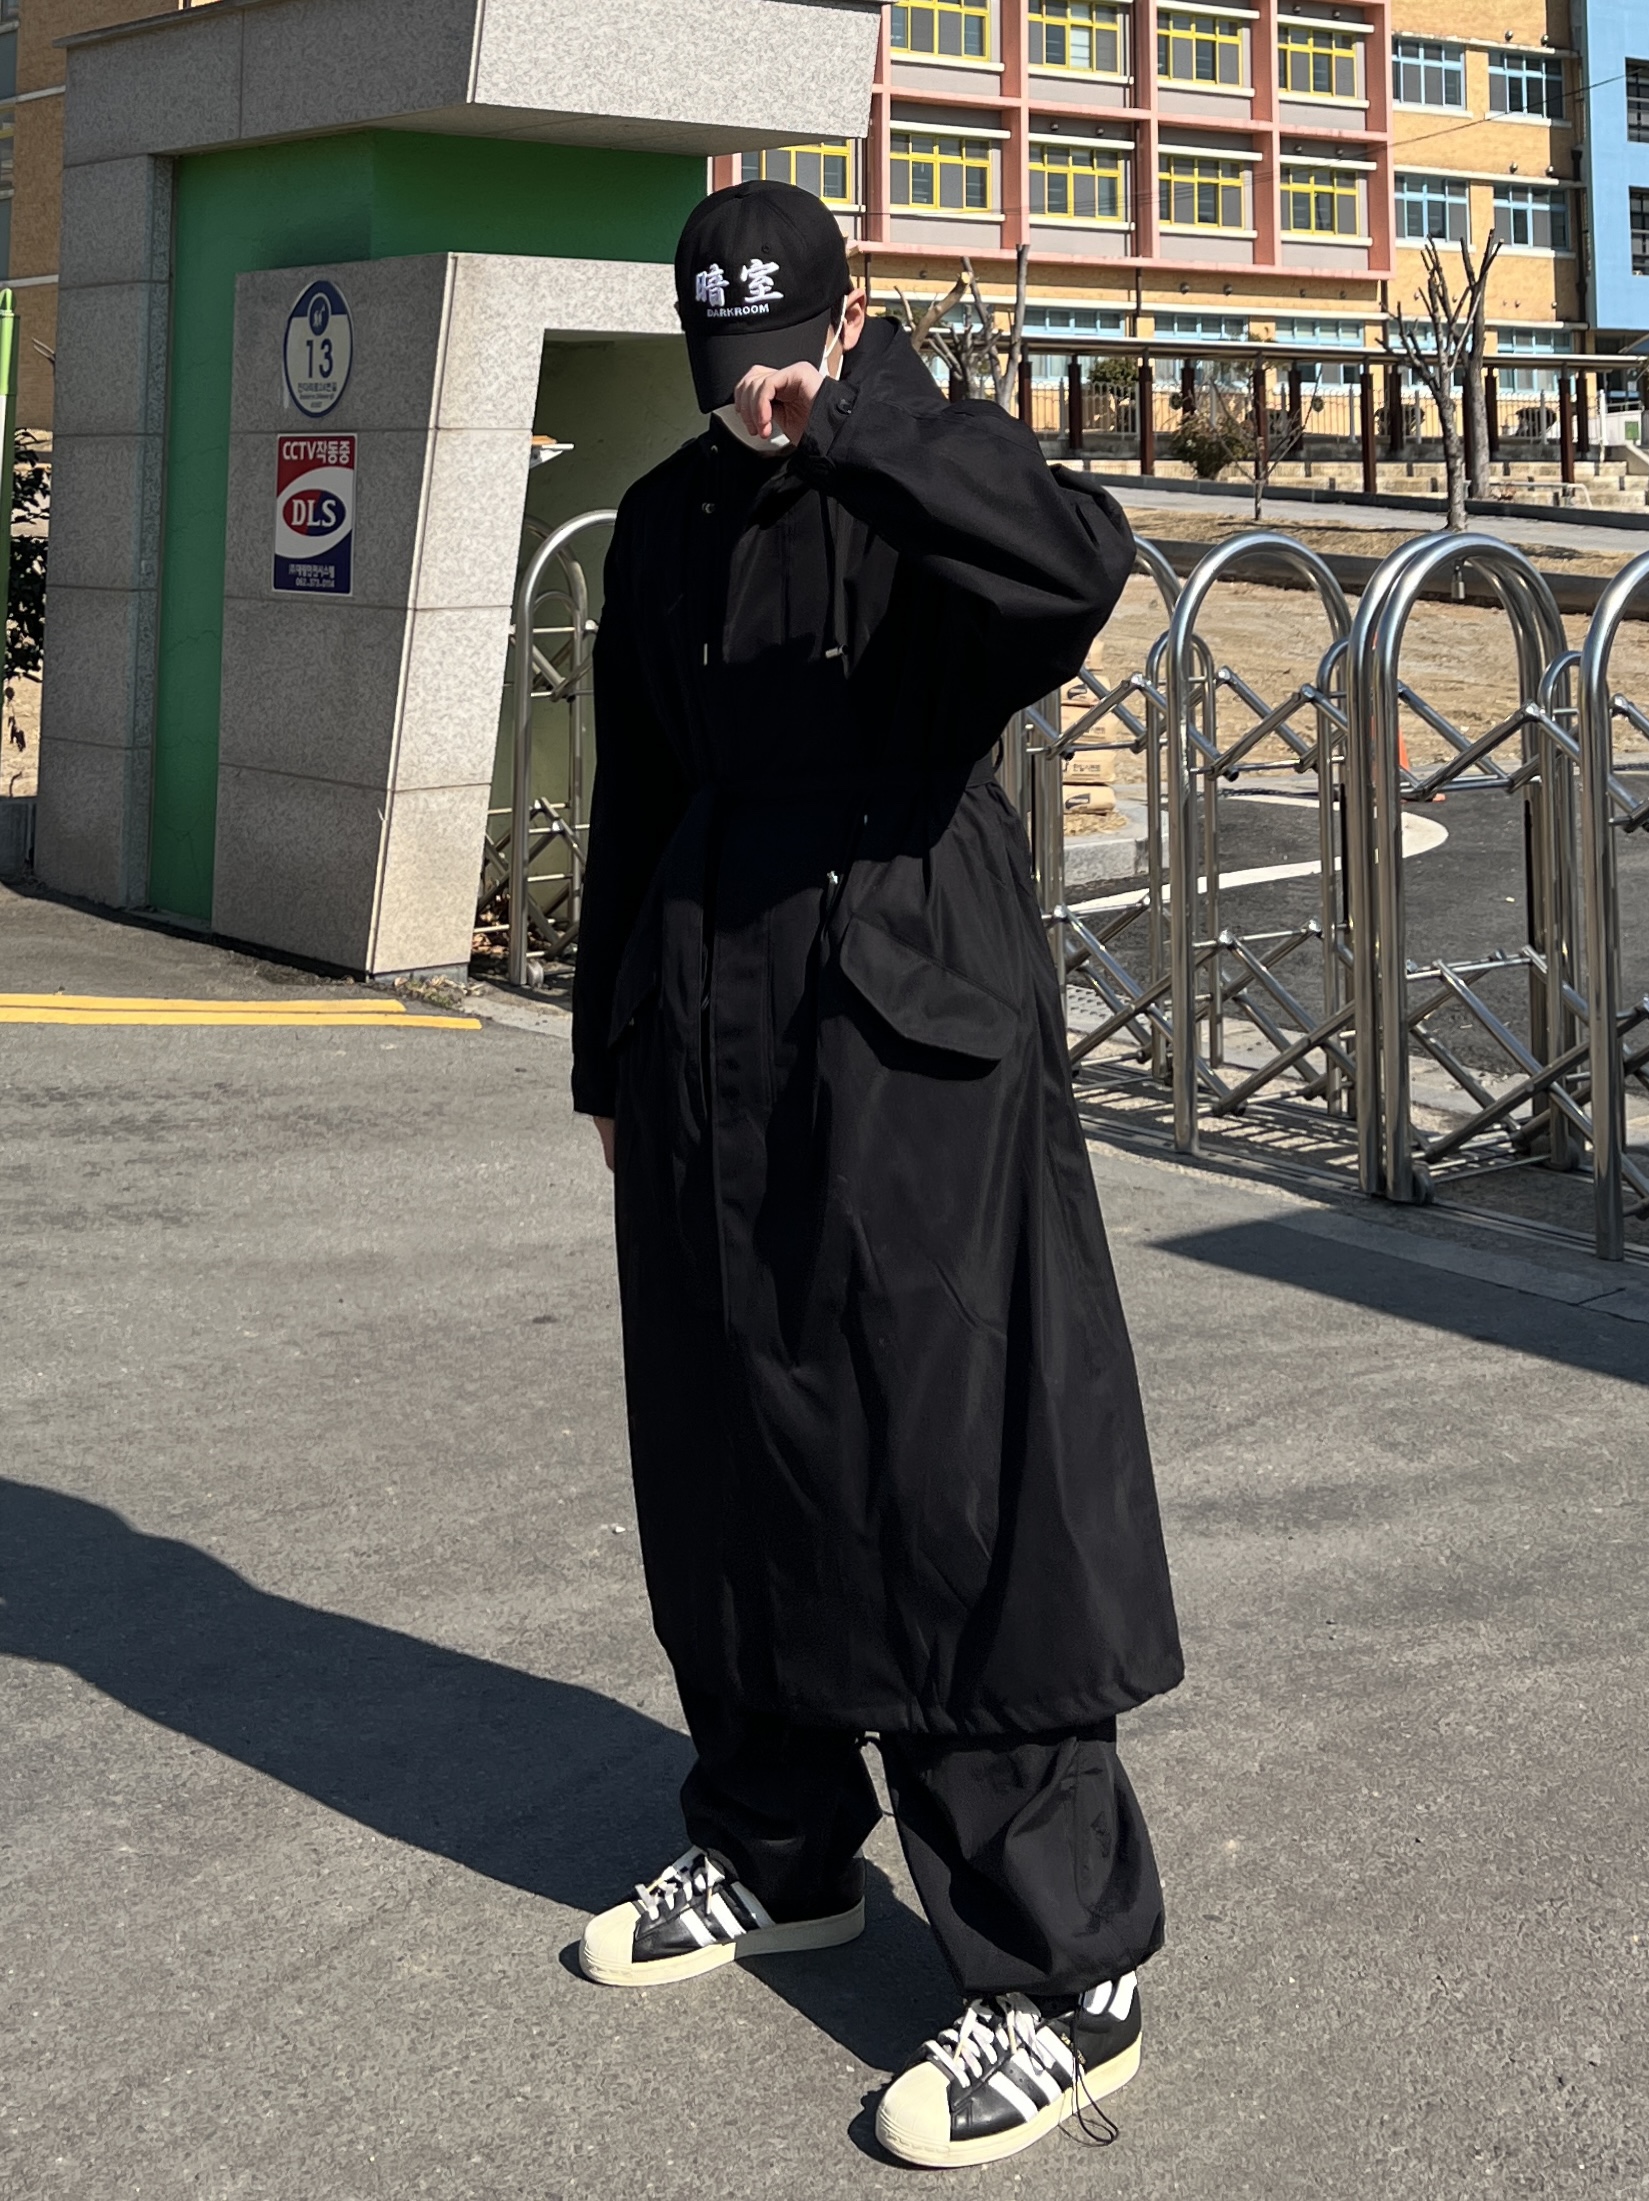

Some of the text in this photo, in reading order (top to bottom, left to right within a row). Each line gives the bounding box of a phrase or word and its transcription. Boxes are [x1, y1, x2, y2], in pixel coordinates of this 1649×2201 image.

[695, 259, 784, 307] 暗室
[707, 304, 770, 317] DARKROOM
[306, 338, 333, 378] 13
[282, 440, 350, 465] CCTV작동중
[291, 499, 337, 528] DLS
